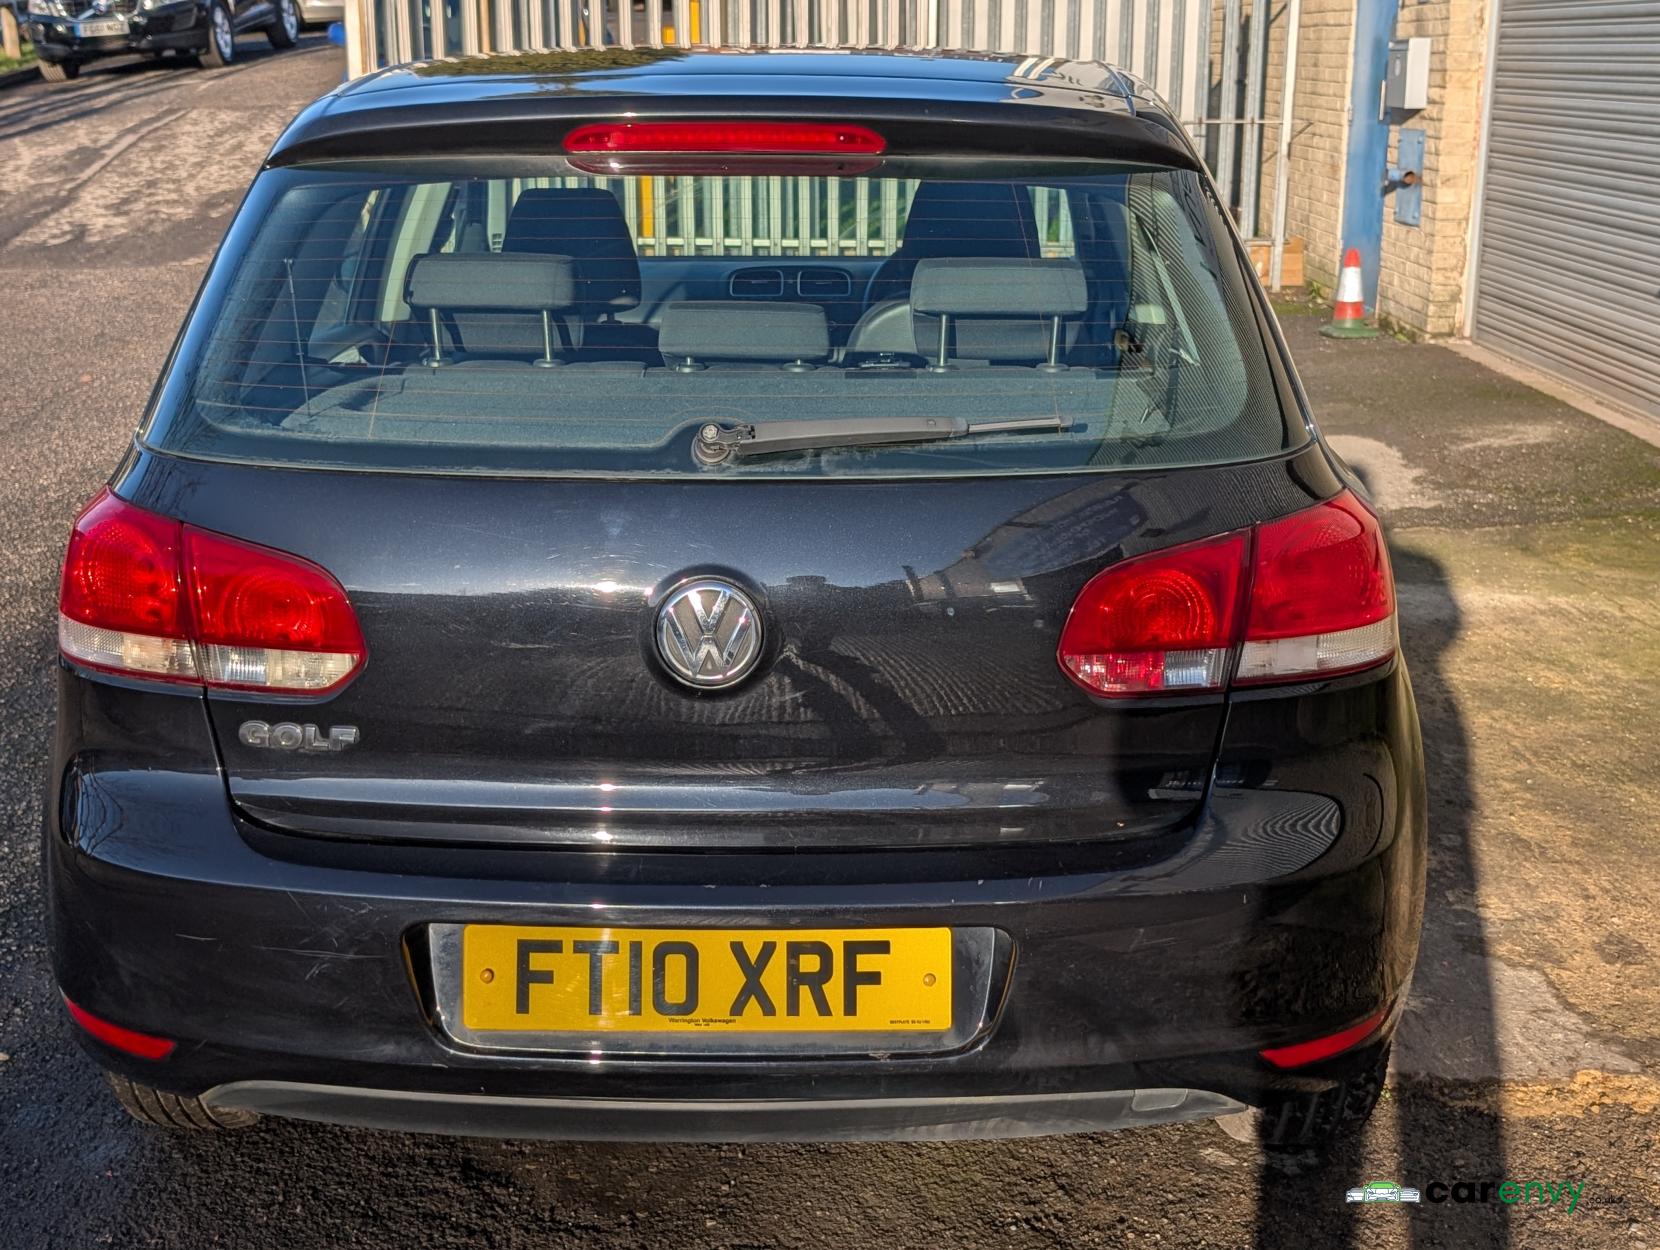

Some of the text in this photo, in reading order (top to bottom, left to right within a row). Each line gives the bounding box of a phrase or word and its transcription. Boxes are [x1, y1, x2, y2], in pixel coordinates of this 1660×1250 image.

[239, 720, 360, 751] GOLF
[515, 939, 891, 1017] FT10 XRF
